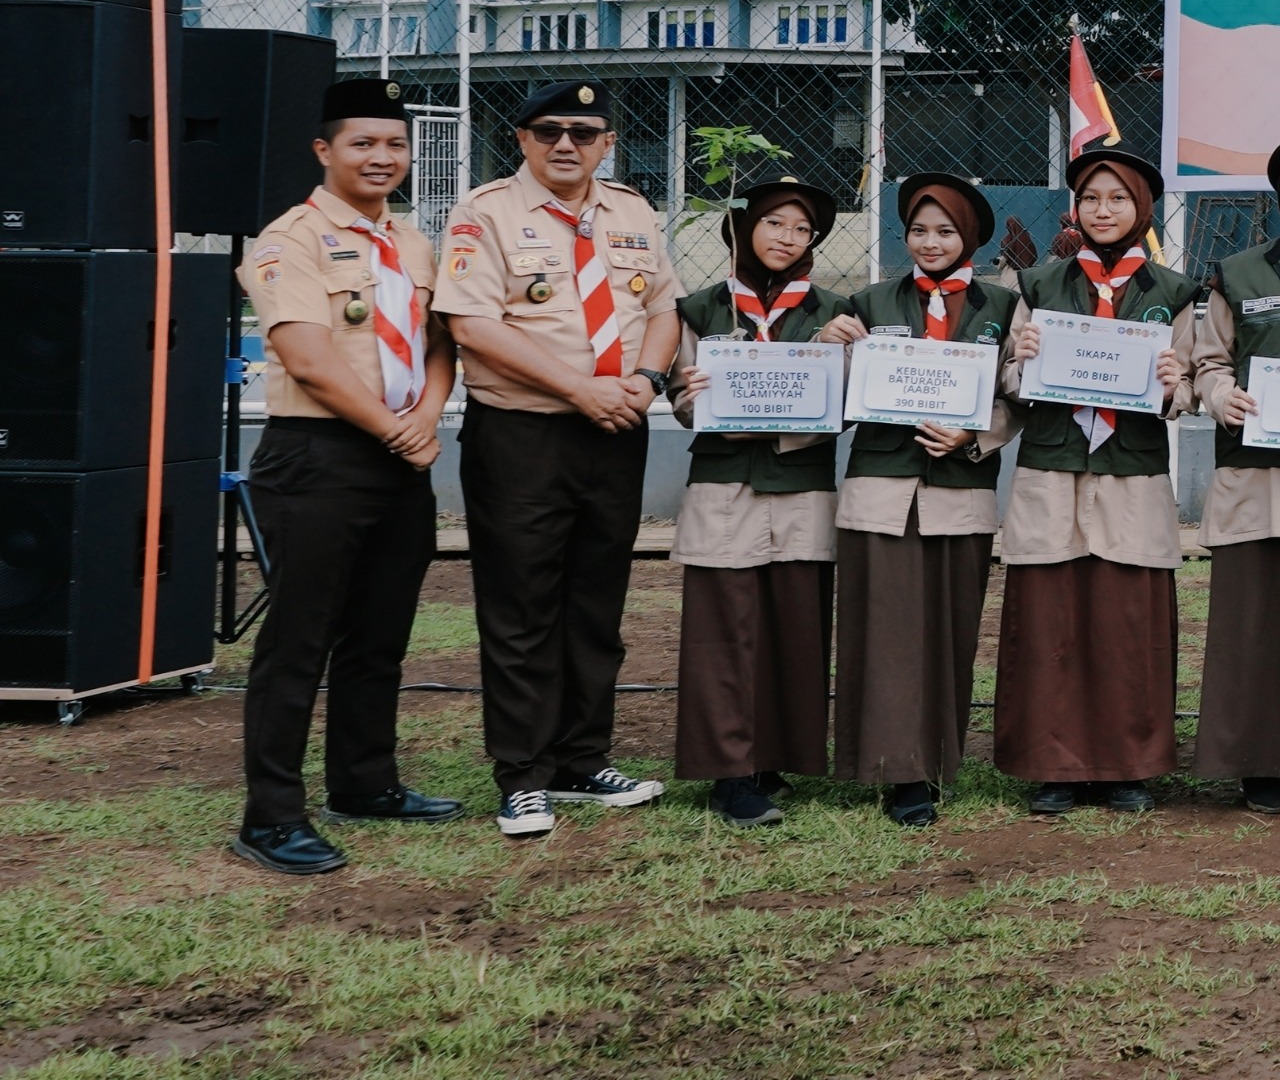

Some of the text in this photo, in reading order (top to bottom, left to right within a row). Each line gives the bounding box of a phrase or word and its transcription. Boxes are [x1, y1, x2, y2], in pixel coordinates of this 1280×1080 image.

[1075, 348, 1121, 362] SIKAPAT
[726, 371, 810, 382] SPORT CENTER
[896, 366, 951, 378] KEBUMEN
[1070, 369, 1120, 383] 700 BIBIT
[729, 380, 806, 391] AL IRSYAD AL
[888, 374, 958, 388] BATURADEN
[732, 389, 803, 399] ISLAMIYYAH
[902, 384, 941, 397] (AABS)
[740, 404, 793, 414] 100 BIBIT
[894, 398, 946, 411] 390 BIBIT
